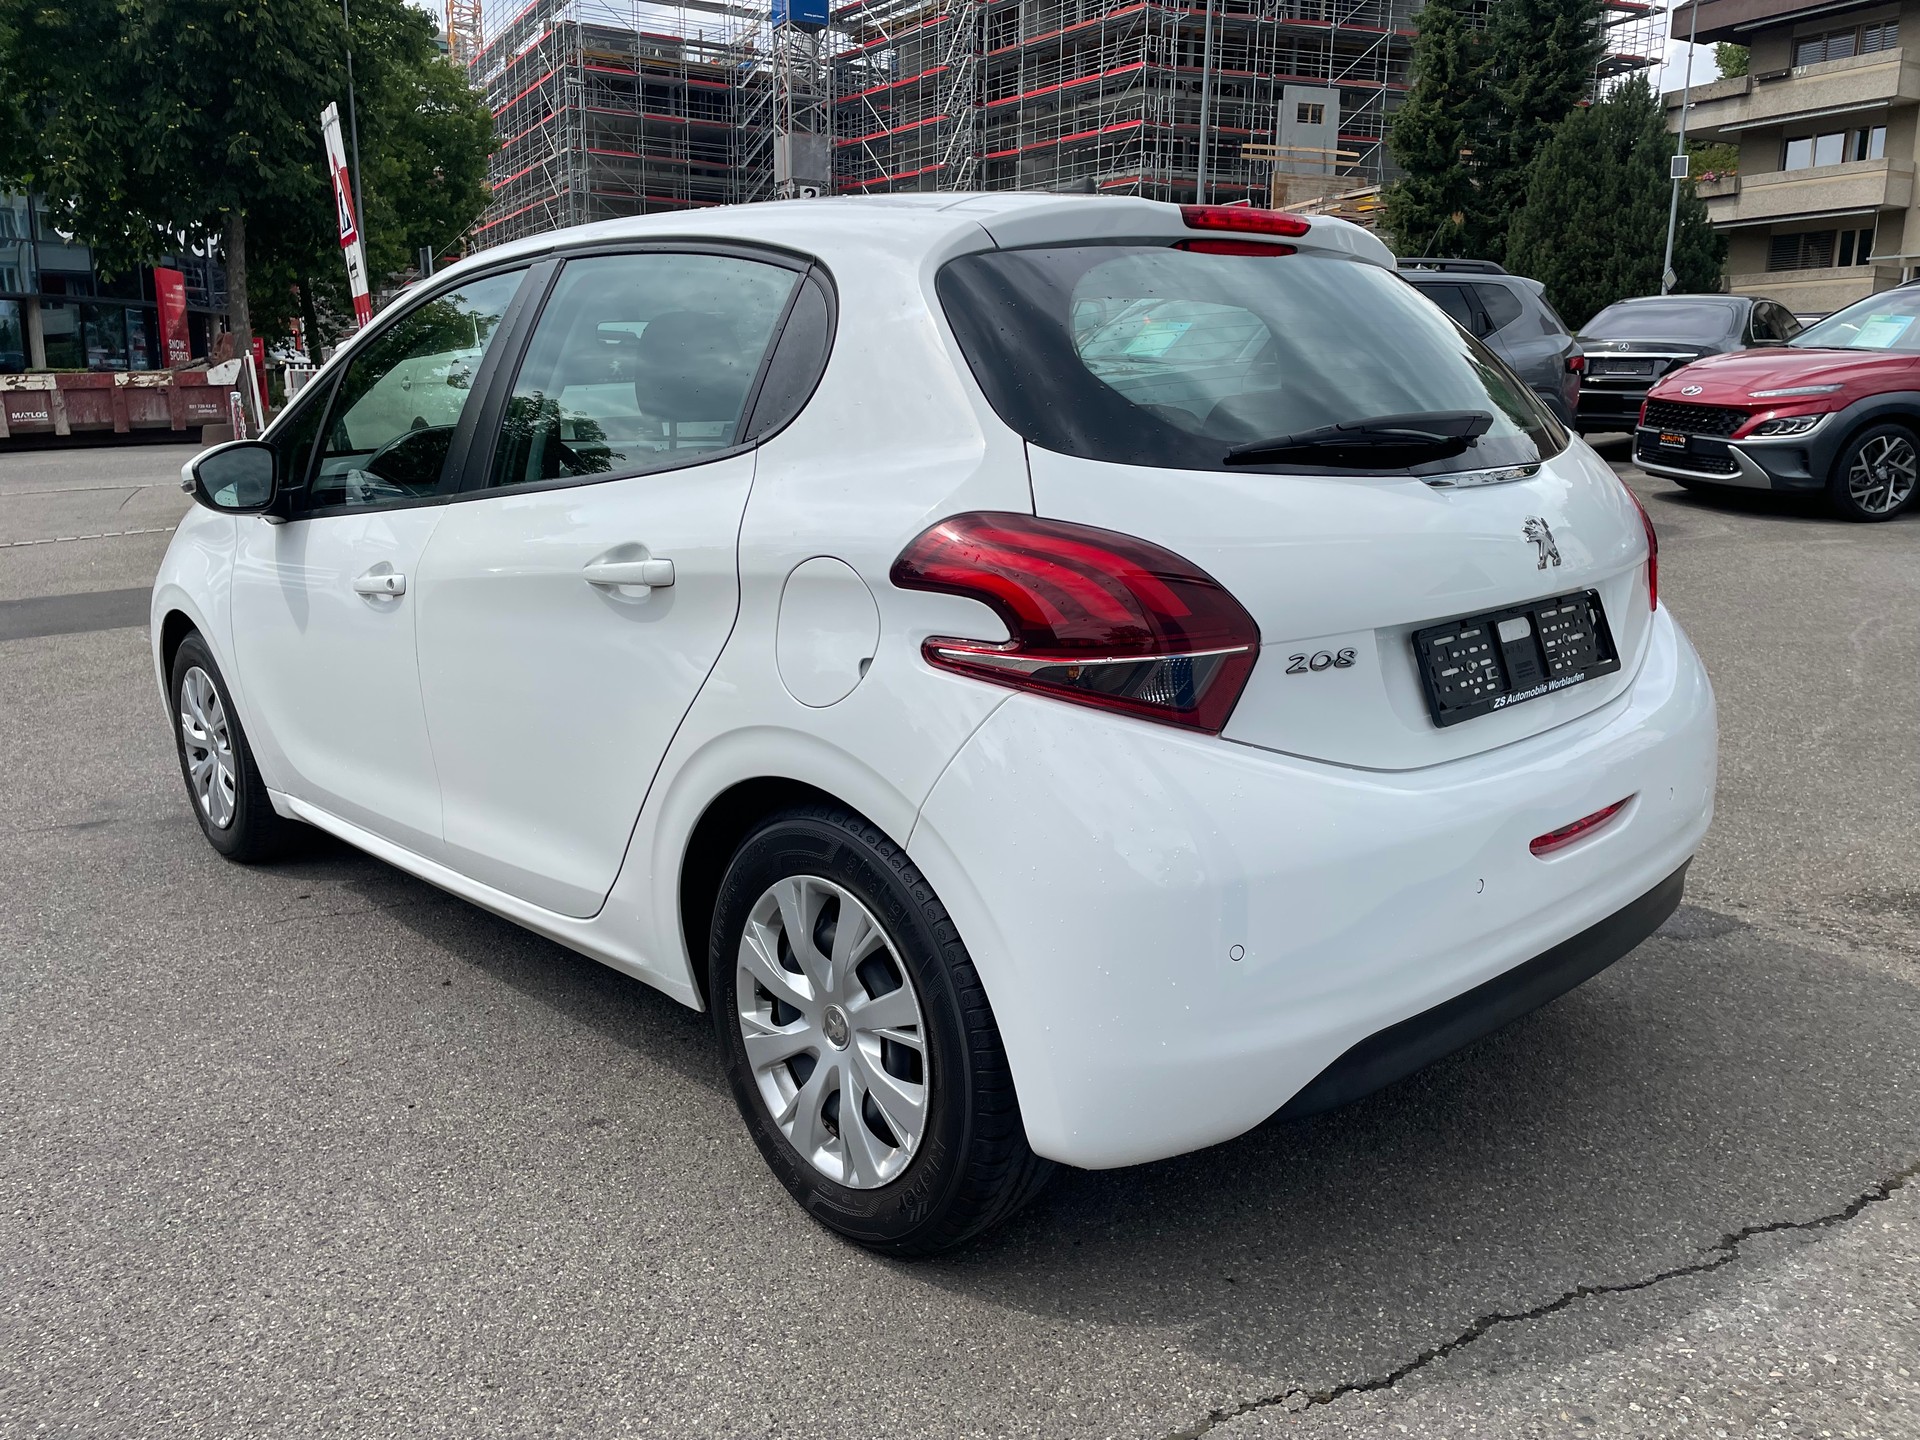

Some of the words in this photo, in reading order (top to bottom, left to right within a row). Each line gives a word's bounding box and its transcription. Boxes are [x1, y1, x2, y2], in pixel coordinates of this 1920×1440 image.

[168, 339, 186, 349] SNOW-
[170, 351, 189, 361] SPORTS
[11, 411, 48, 419] MATLOG
[1286, 647, 1358, 674] 208
[1493, 696, 1506, 709] ZS
[1506, 683, 1548, 705] Automobile
[1548, 672, 1585, 691] Worblaufen
